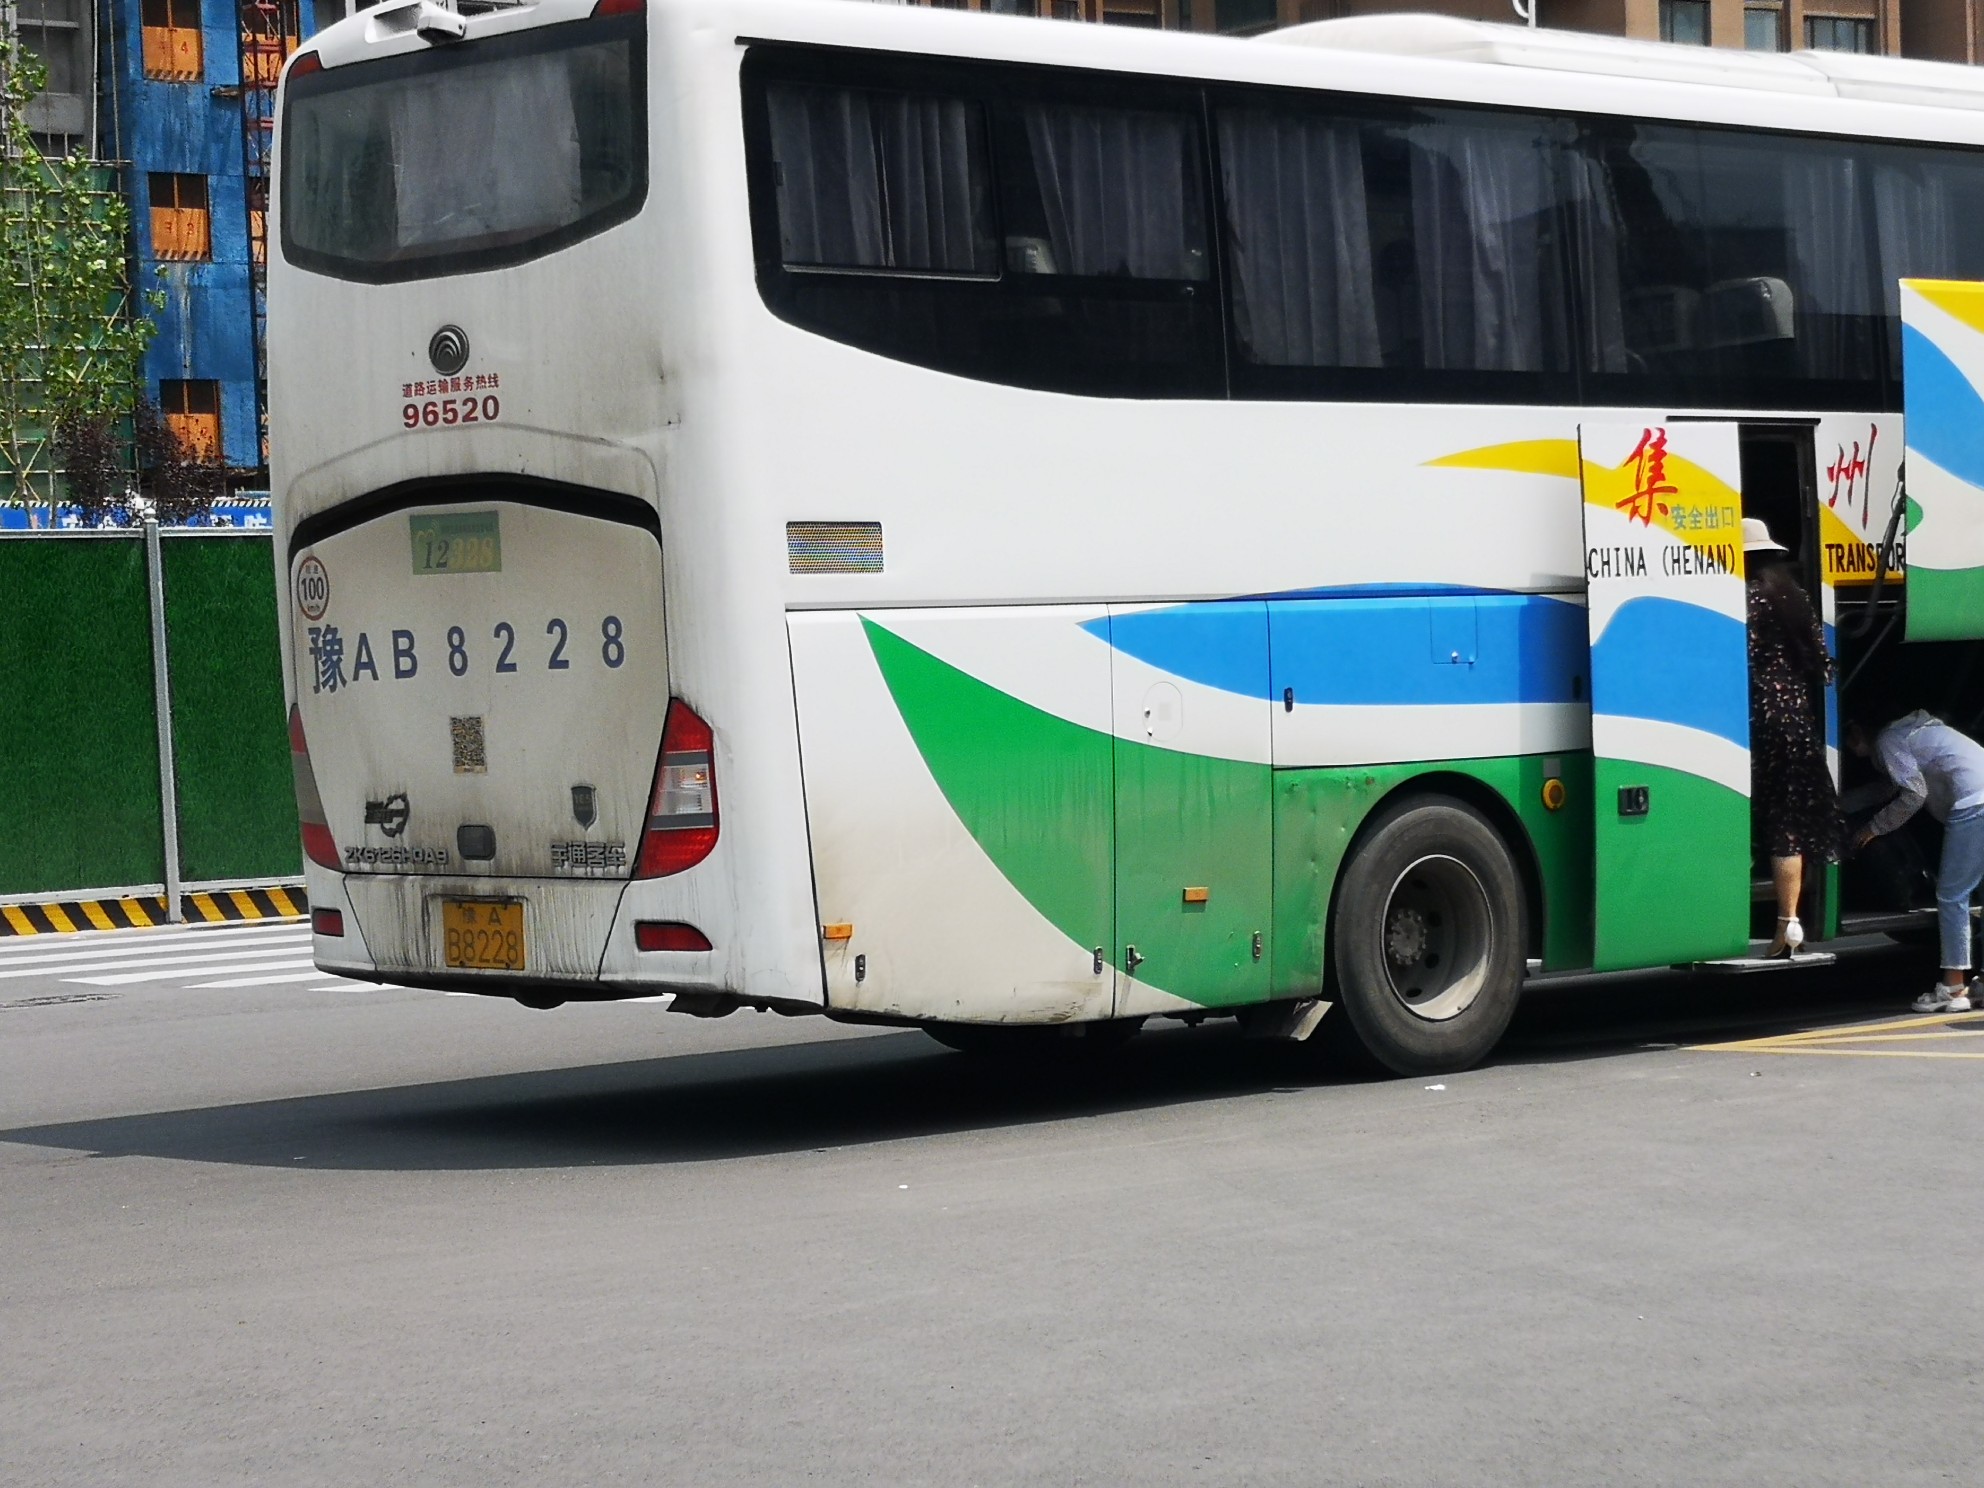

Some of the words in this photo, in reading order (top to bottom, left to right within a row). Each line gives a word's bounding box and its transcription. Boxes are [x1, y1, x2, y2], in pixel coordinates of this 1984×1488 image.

[402, 373, 499, 398] 道路运输服务热线
[402, 395, 500, 428] 96520
[1615, 426, 1678, 528] 集
[1826, 422, 1878, 530] 州
[1671, 504, 1734, 530] 安全出口
[1588, 547, 1647, 578] CHINA
[1662, 544, 1735, 577] (HENAN)
[301, 577, 325, 600] 100
[551, 841, 627, 867] 宇通客车
[448, 928, 518, 964] B8228
